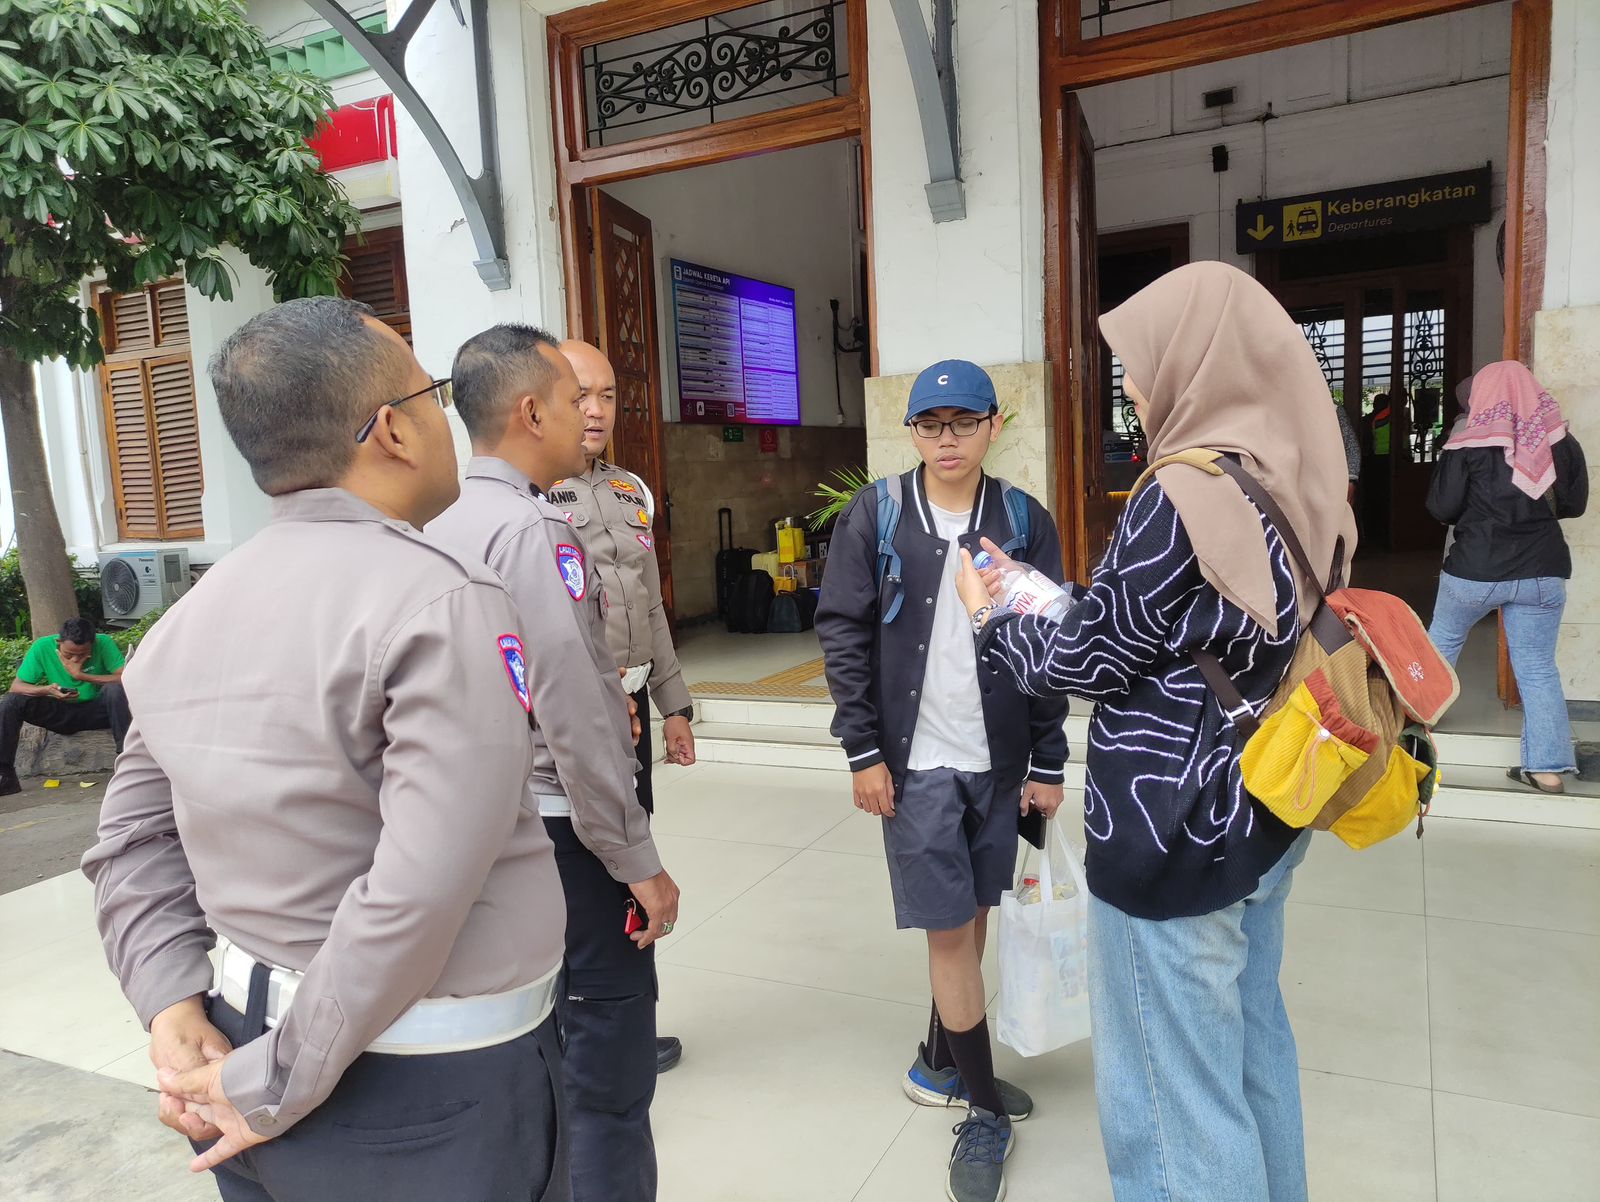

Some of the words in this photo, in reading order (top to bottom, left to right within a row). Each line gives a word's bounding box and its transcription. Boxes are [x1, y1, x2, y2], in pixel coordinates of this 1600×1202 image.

[1328, 184, 1476, 215] Keberangkatan
[1328, 216, 1393, 232] Departures
[683, 268, 703, 279] JADWAL
[704, 273, 722, 283] KERETA
[722, 277, 731, 286] API
[937, 374, 949, 386] C
[613, 491, 647, 509] POLRI
